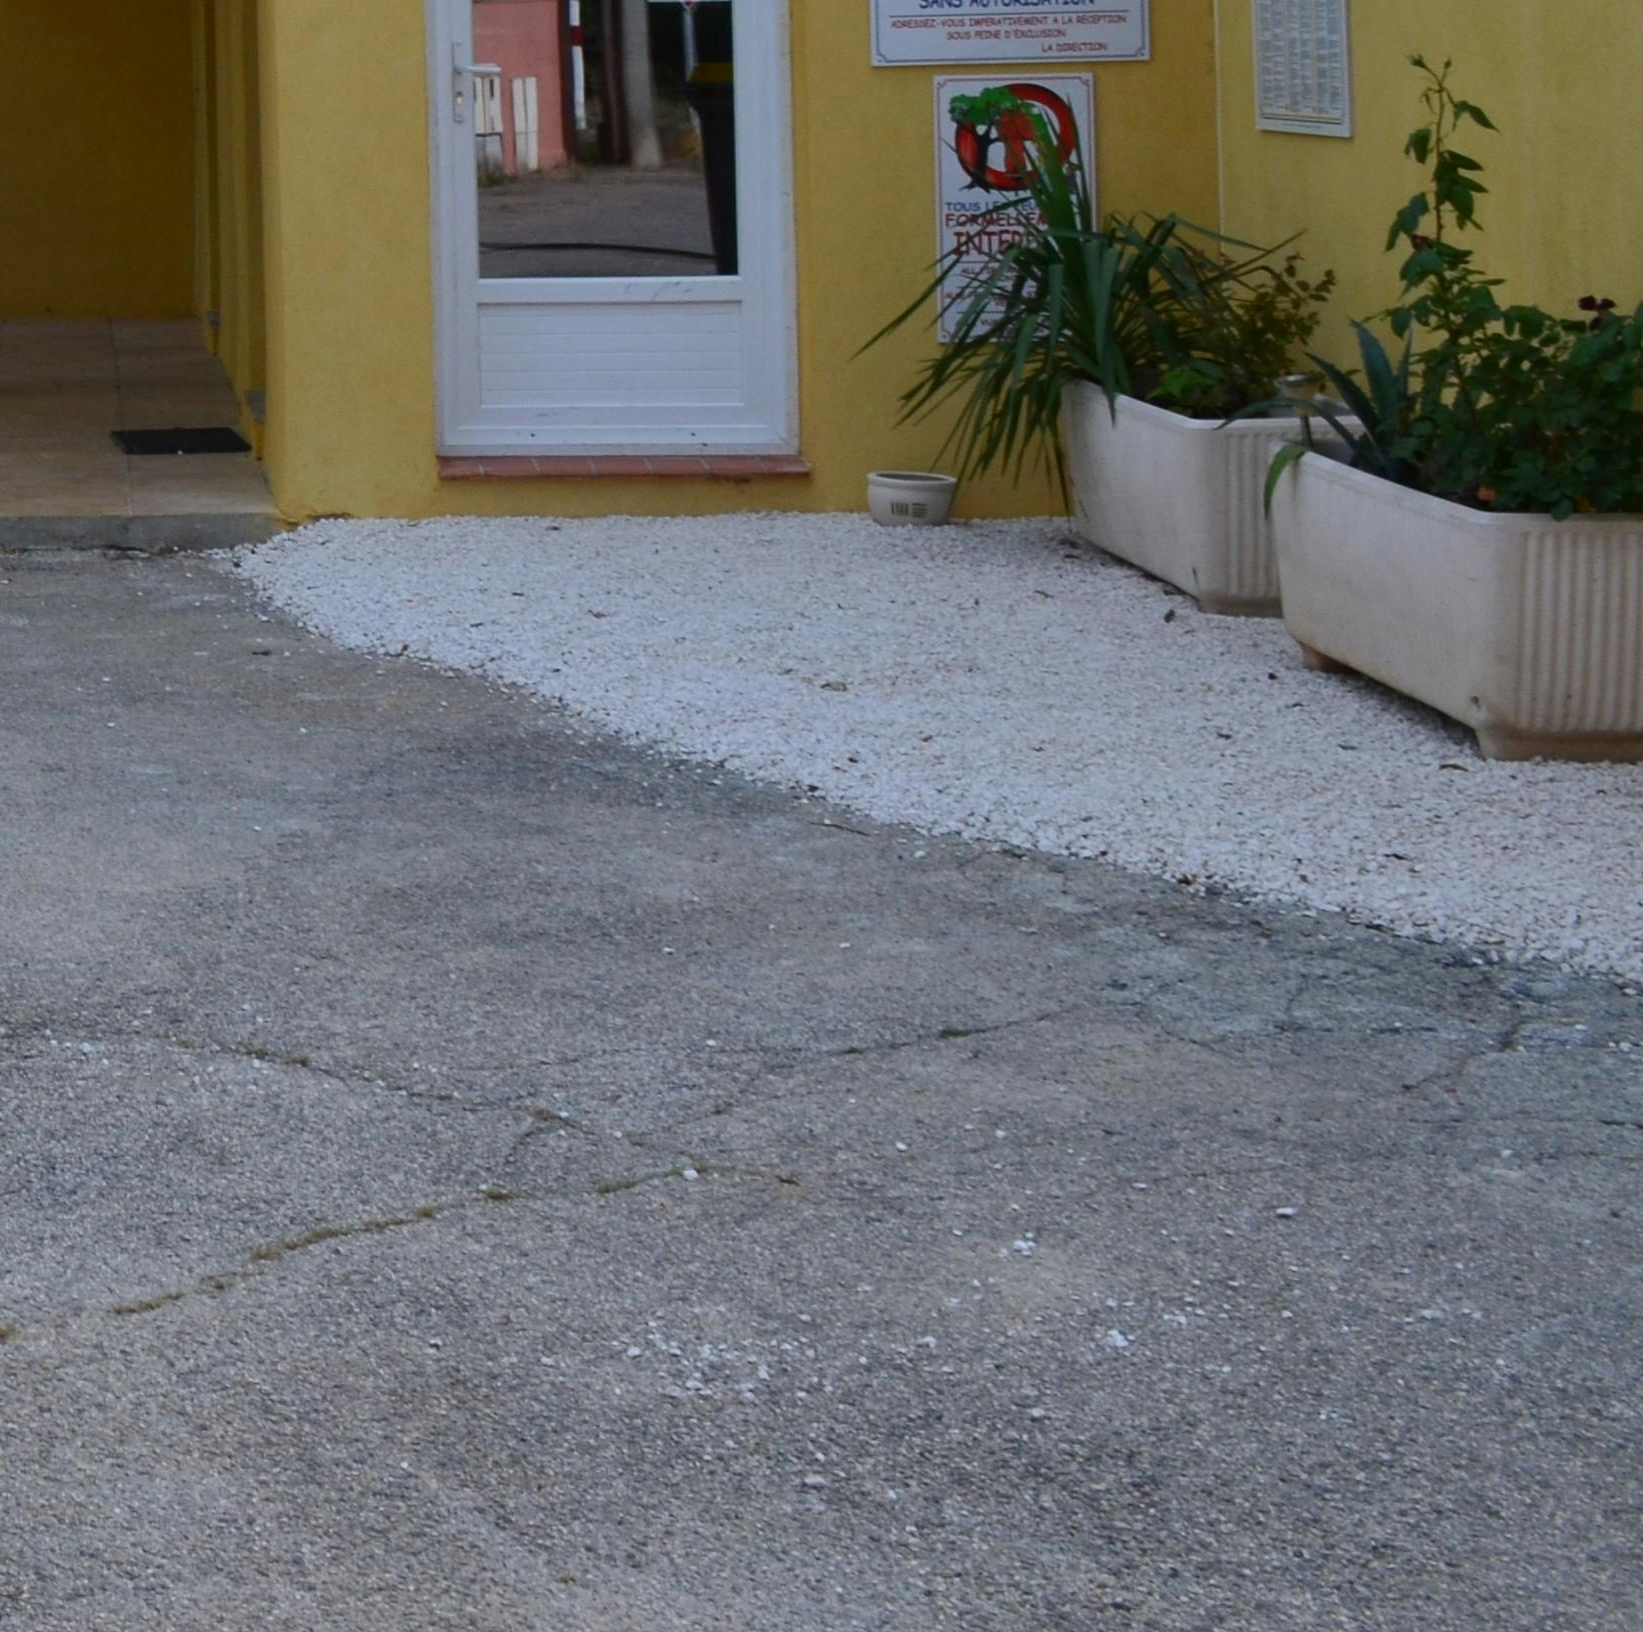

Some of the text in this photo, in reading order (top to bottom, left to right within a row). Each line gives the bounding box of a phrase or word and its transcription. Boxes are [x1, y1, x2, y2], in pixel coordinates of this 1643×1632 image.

[1061, 15, 1073, 25] LA
[947, 30, 971, 41] SOUS
[974, 29, 1001, 40] PEINE
[1041, 41, 1108, 53] LA DIRECTION
[944, 200, 982, 213] TOUS
